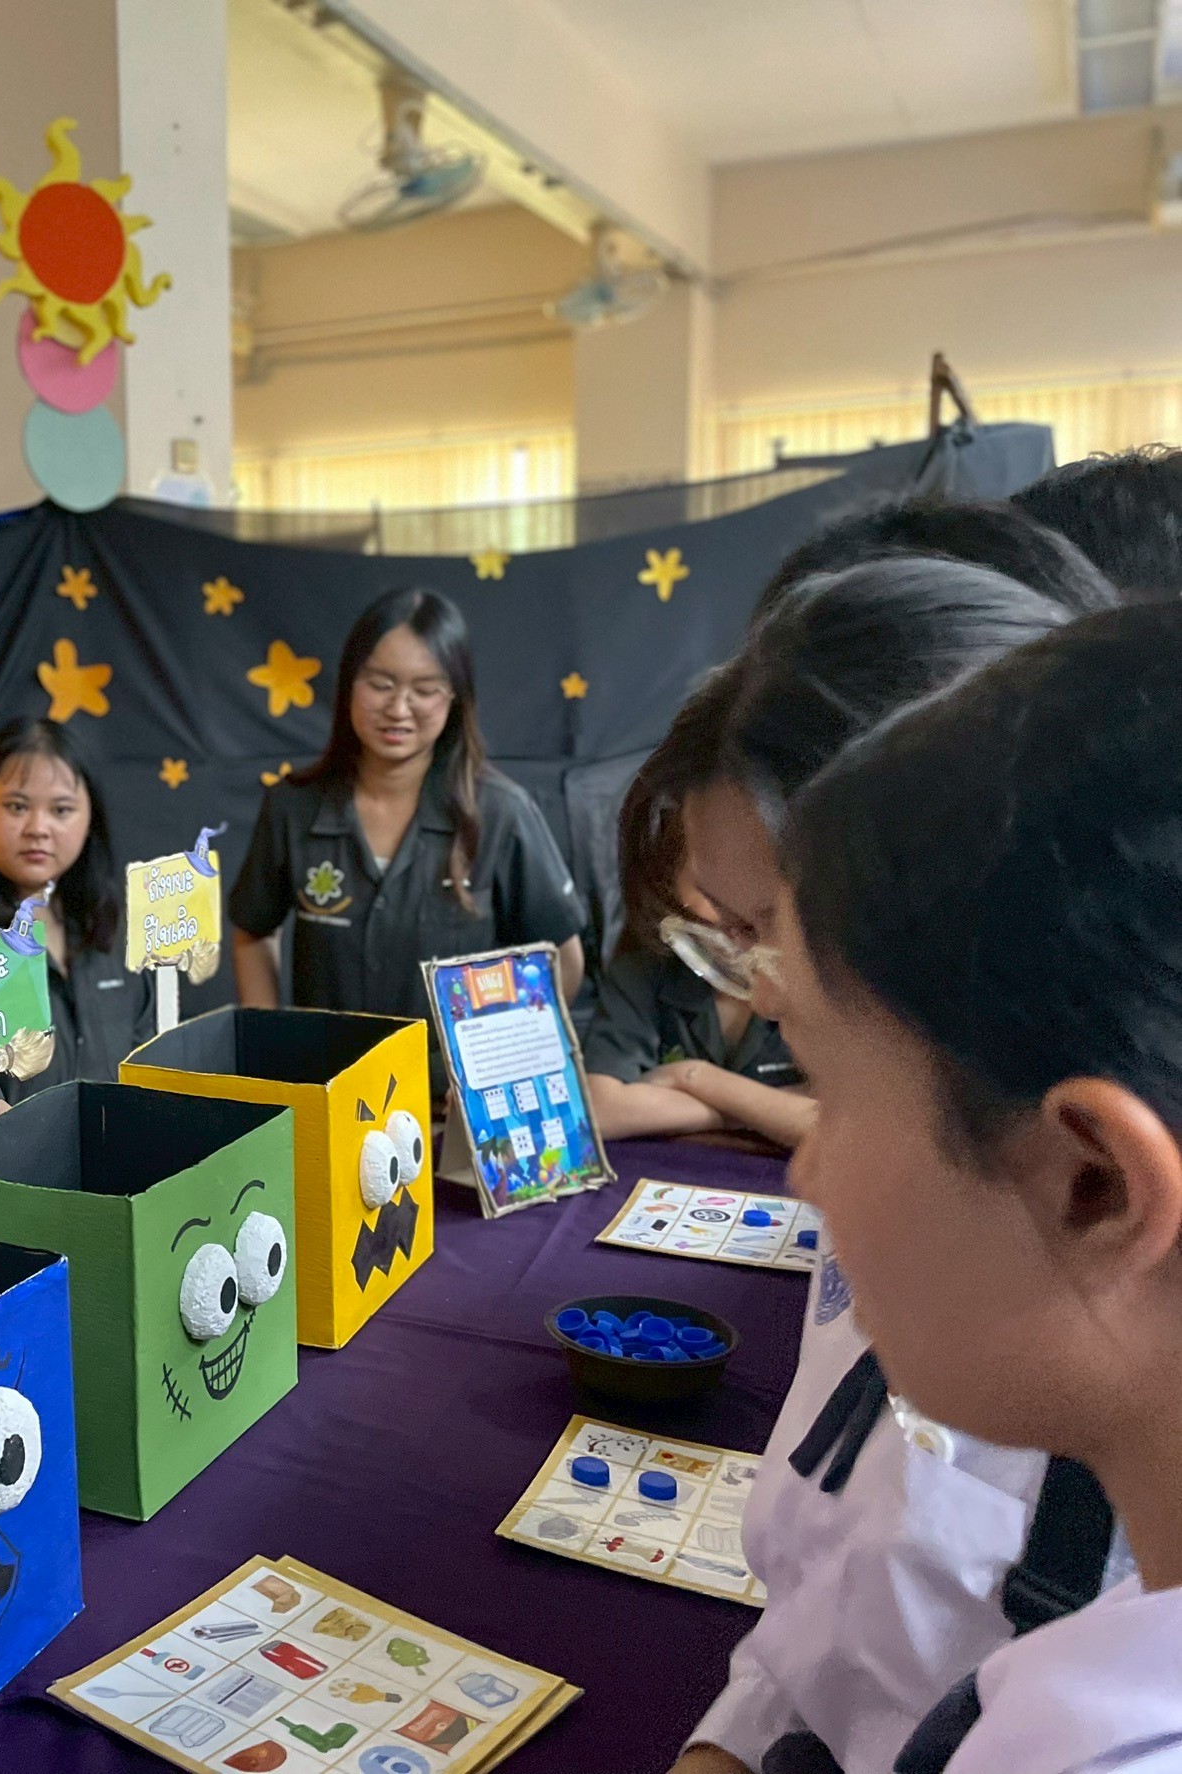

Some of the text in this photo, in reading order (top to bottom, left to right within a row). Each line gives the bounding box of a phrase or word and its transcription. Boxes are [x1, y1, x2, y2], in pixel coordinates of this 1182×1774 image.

[148, 866, 194, 903] ถังขยะ
[143, 905, 198, 952] รีไซเคิล
